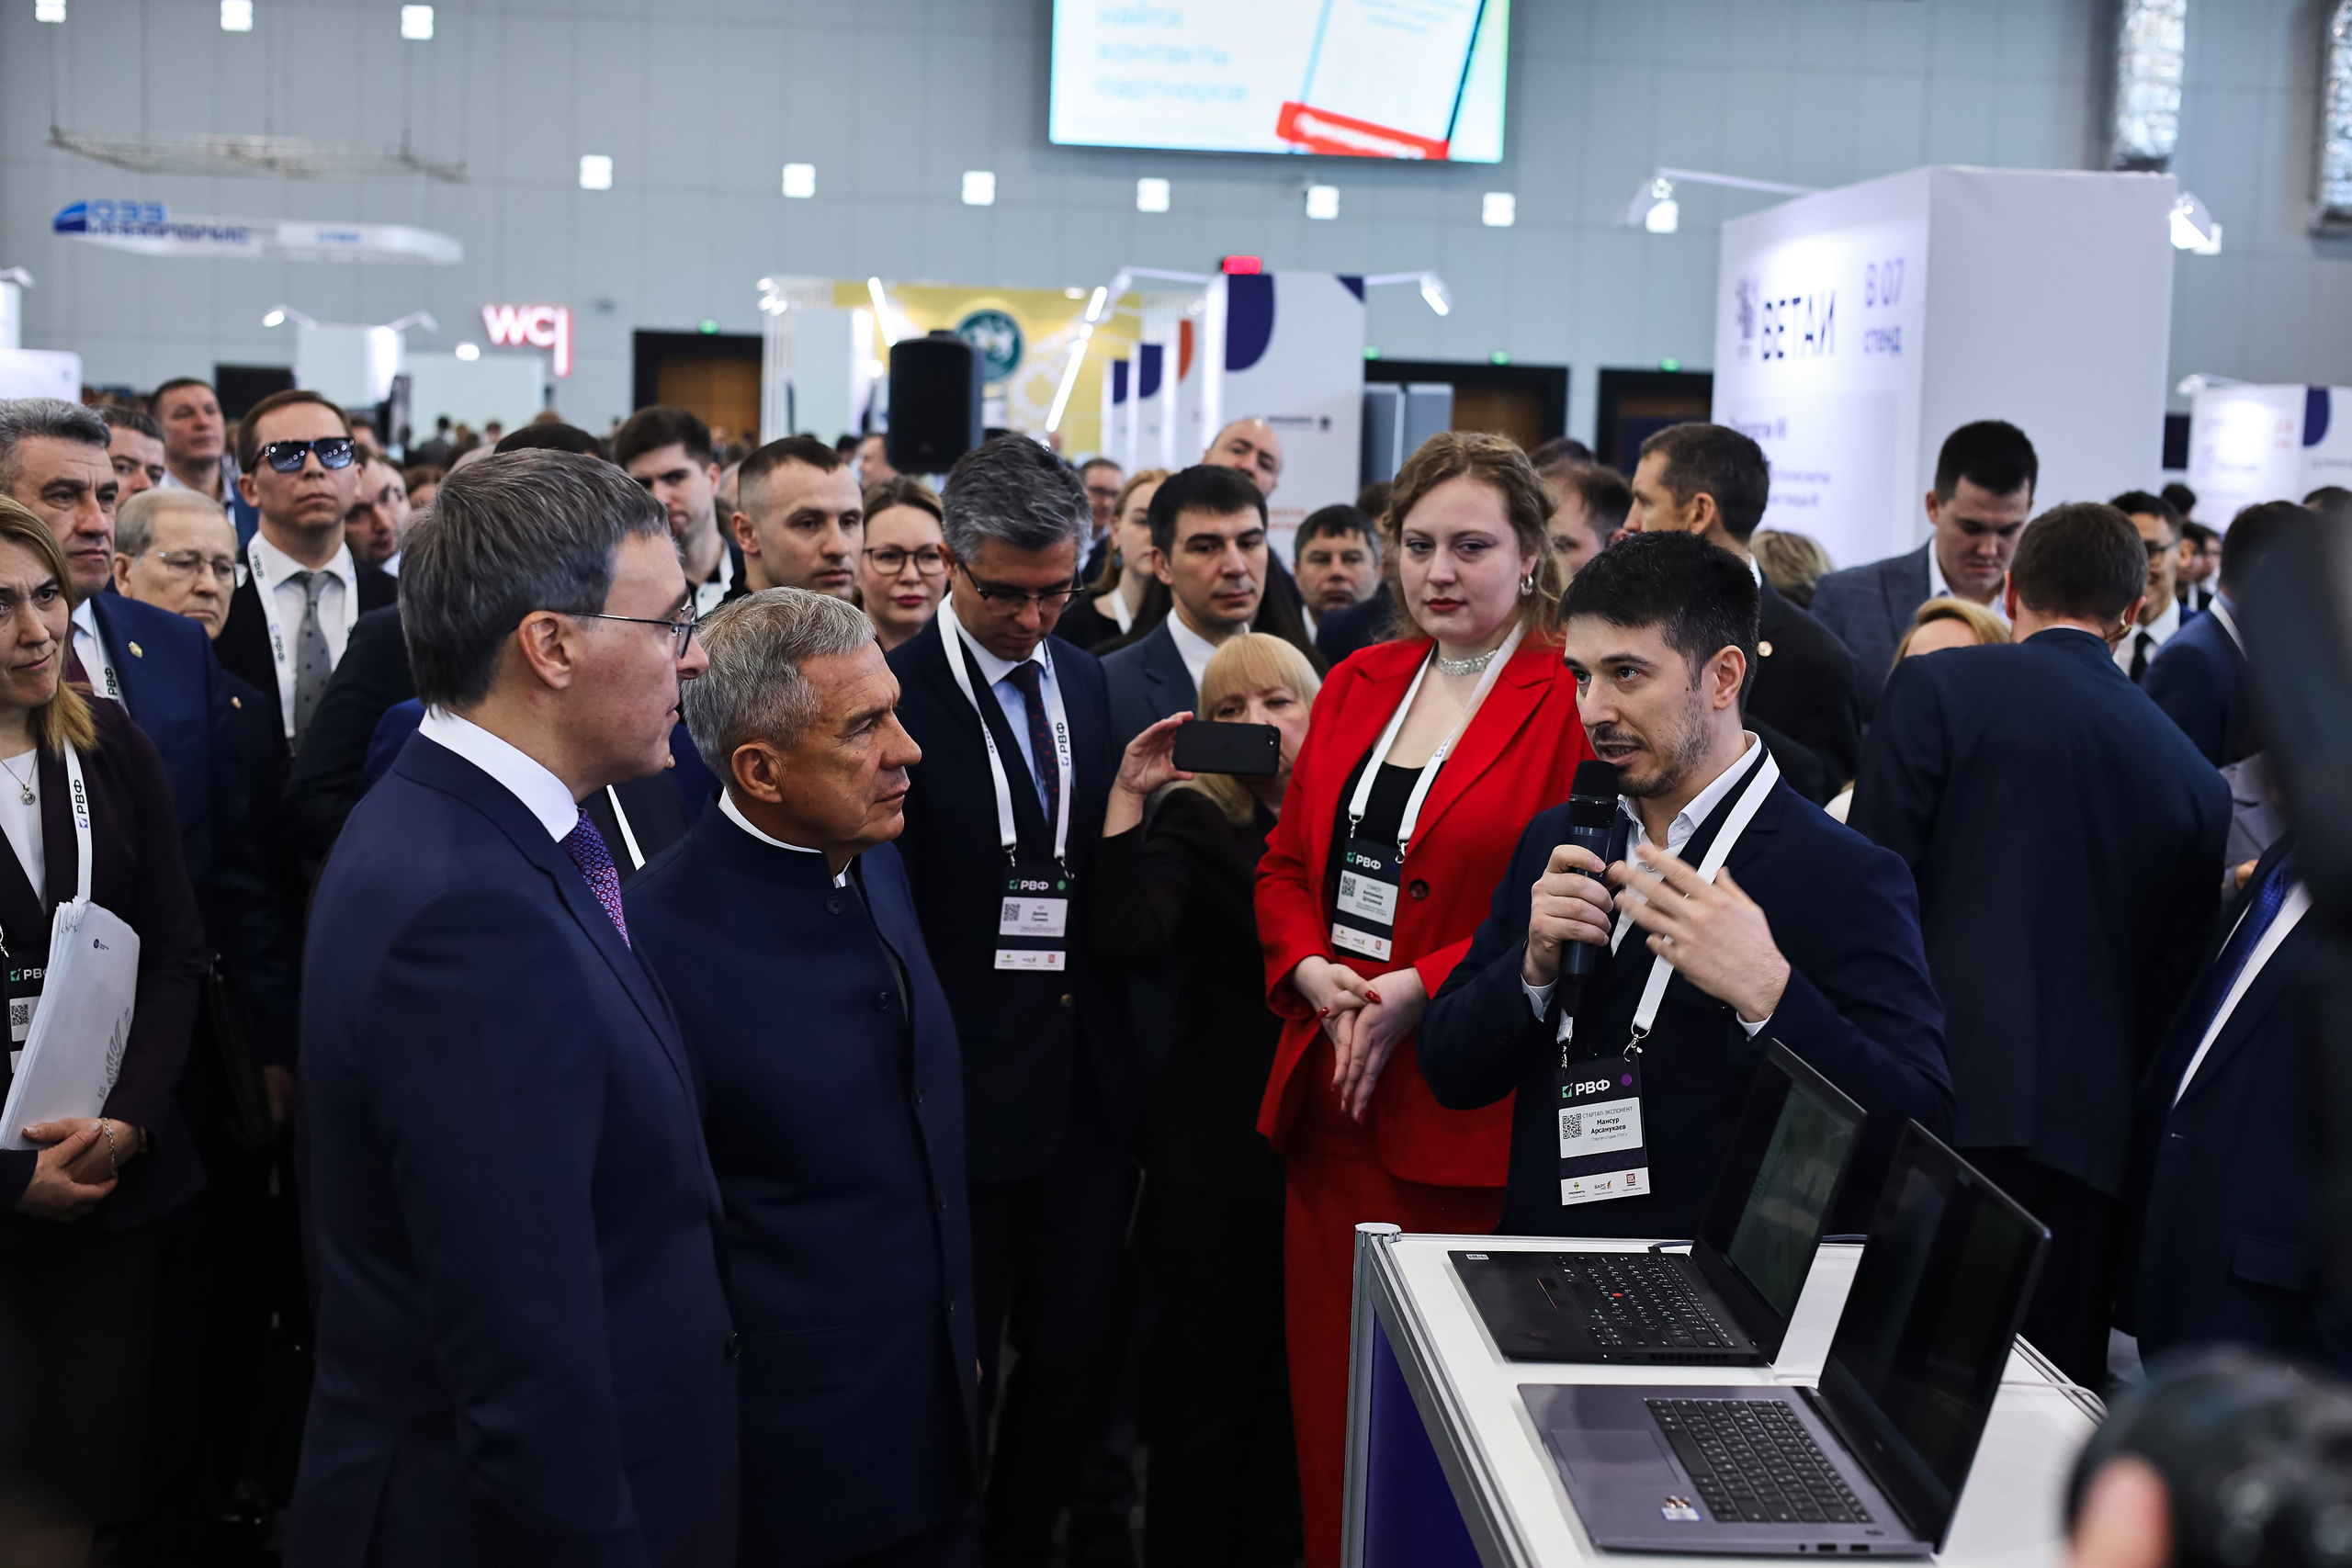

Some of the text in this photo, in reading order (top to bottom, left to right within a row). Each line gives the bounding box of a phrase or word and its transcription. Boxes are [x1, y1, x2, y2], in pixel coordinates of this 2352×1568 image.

[105, 667, 118, 695] РВФ
[1057, 722, 1069, 753] РВФ
[74, 779, 86, 815] РВФ
[1355, 854, 1382, 871] РВФ
[1020, 880, 1049, 890] РВФ
[1575, 1078, 1611, 1097] РВФ
[1582, 1106, 1634, 1119] СТАРТАП-ЭКСПОНЕНТ
[1590, 1124, 1626, 1135] Арсанукаев
[1596, 1117, 1620, 1126] Мансур
